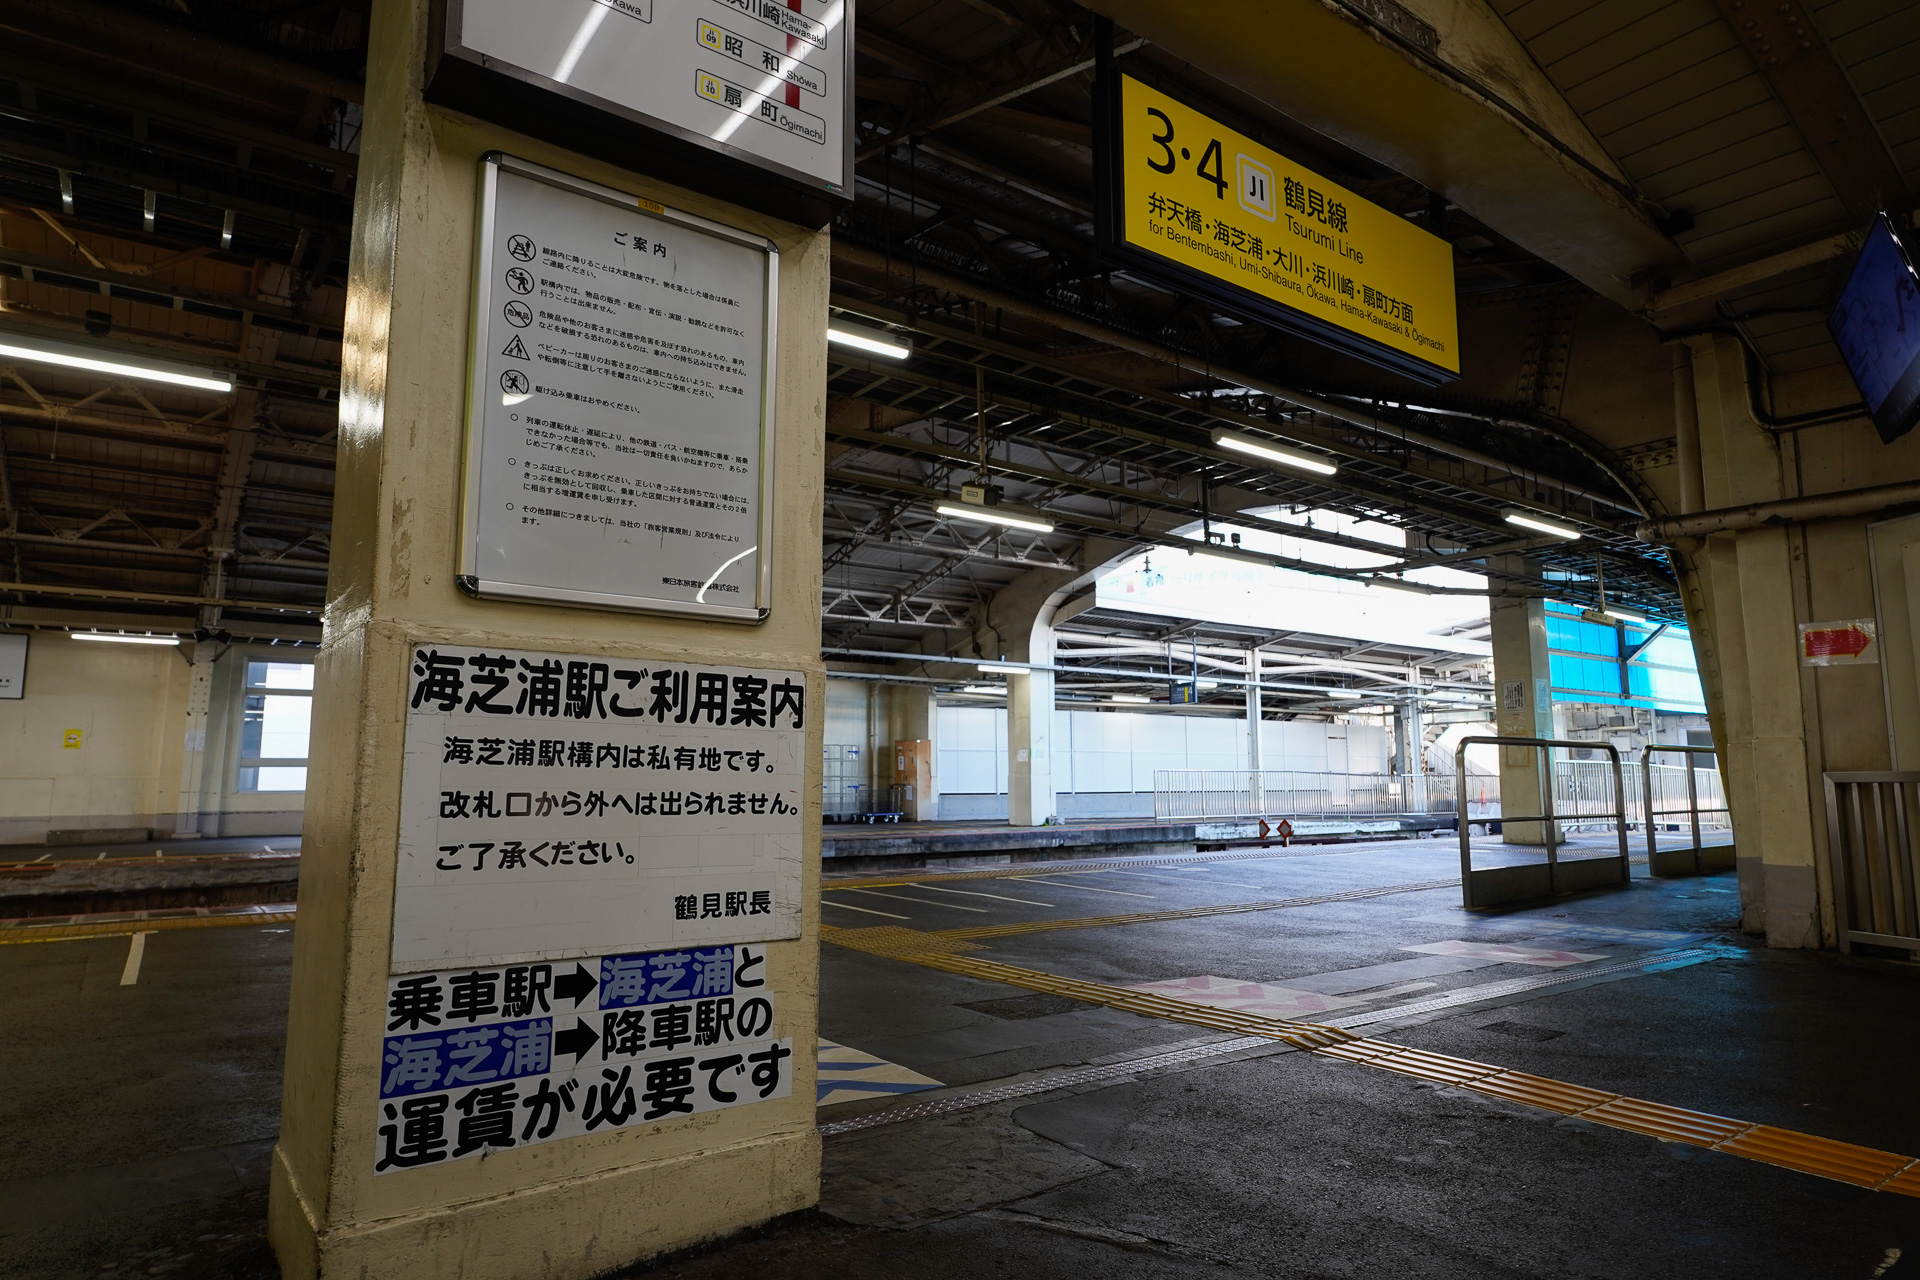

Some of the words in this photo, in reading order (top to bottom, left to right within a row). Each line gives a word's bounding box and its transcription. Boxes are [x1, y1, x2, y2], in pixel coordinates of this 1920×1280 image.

[781, 10, 812, 30] Hama-
[781, 19, 824, 46] Kawasaki
[706, 33, 717, 44] 09
[705, 85, 716, 95] 10
[780, 114, 824, 141] Ōgimachi
[1249, 175, 1265, 202] JI
[1283, 176, 1349, 234] 鶴見線
[614, 231, 667, 258] ご案内
[1284, 213, 1335, 252] Tsurumi
[1338, 240, 1364, 265] Line
[542, 258, 597, 280] ご連絡ください。
[1148, 219, 1164, 235] for
[1166, 226, 1237, 268] Bentembashi,
[1239, 258, 1305, 295] Umi-Shibaura,
[1340, 300, 1403, 336] Hama-Kawasaki
[1404, 326, 1411, 339] &
[540, 290, 617, 316] 行うことは出来ません。
[535, 386, 641, 414] 駆け込み乗車はおやめください。
[525, 439, 596, 459] じめご了承ください。
[523, 484, 638, 508] に相当する増運賃を申し受けます。
[521, 517, 540, 526] ます。
[411, 650, 805, 729] 海芝浦駅ご利用案内
[443, 736, 774, 774] 海芝浦駅構内は私有地です。
[439, 790, 798, 819] 改札口から外へは出られません。
[436, 840, 635, 871] ご了承ください。
[674, 890, 772, 921] 鶴見駅長
[387, 964, 553, 1032] 乗車駅
[383, 1020, 553, 1095] 海芝浦
[601, 997, 774, 1061] 降車駅の
[375, 1043, 792, 1173] 運賃が必要です
